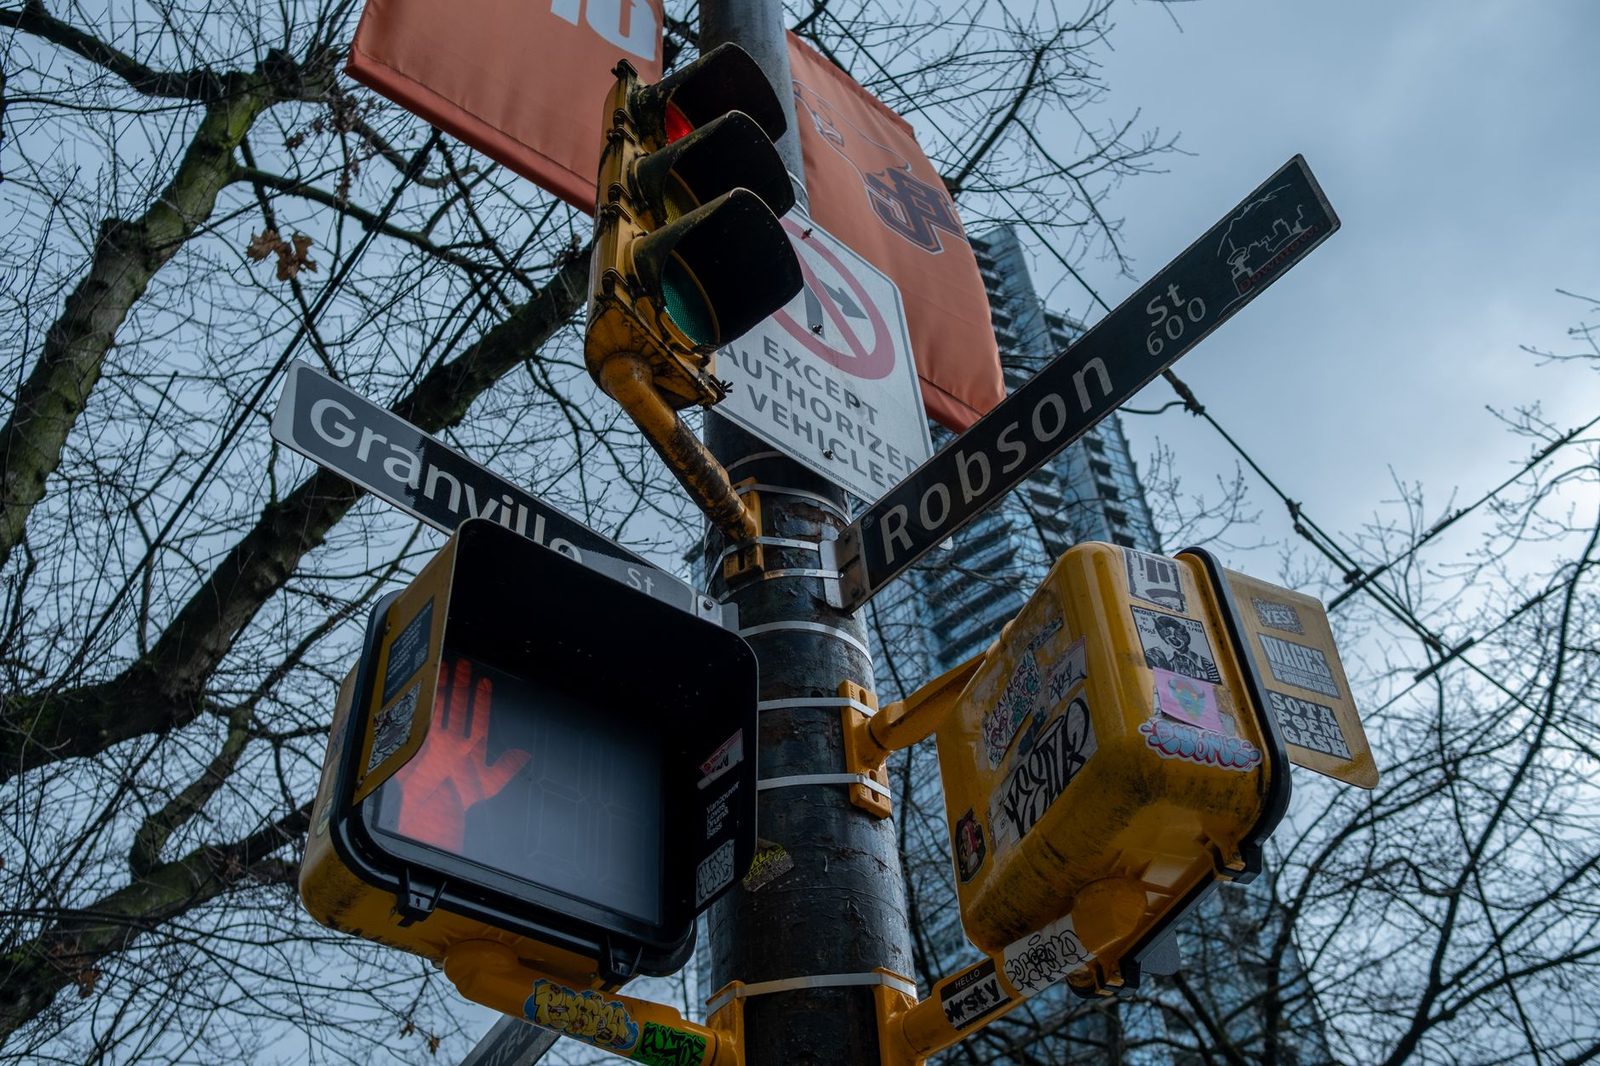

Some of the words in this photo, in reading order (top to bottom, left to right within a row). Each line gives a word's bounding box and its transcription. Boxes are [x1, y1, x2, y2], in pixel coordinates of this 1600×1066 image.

[1145, 297, 1207, 357] 600
[763, 335, 878, 426] EXCEPT
[879, 356, 1113, 565] Robson
[1146, 280, 1188, 327] St
[626, 567, 655, 595] St
[1269, 693, 1337, 726] SOTA
[955, 969, 981, 990] HELLO
